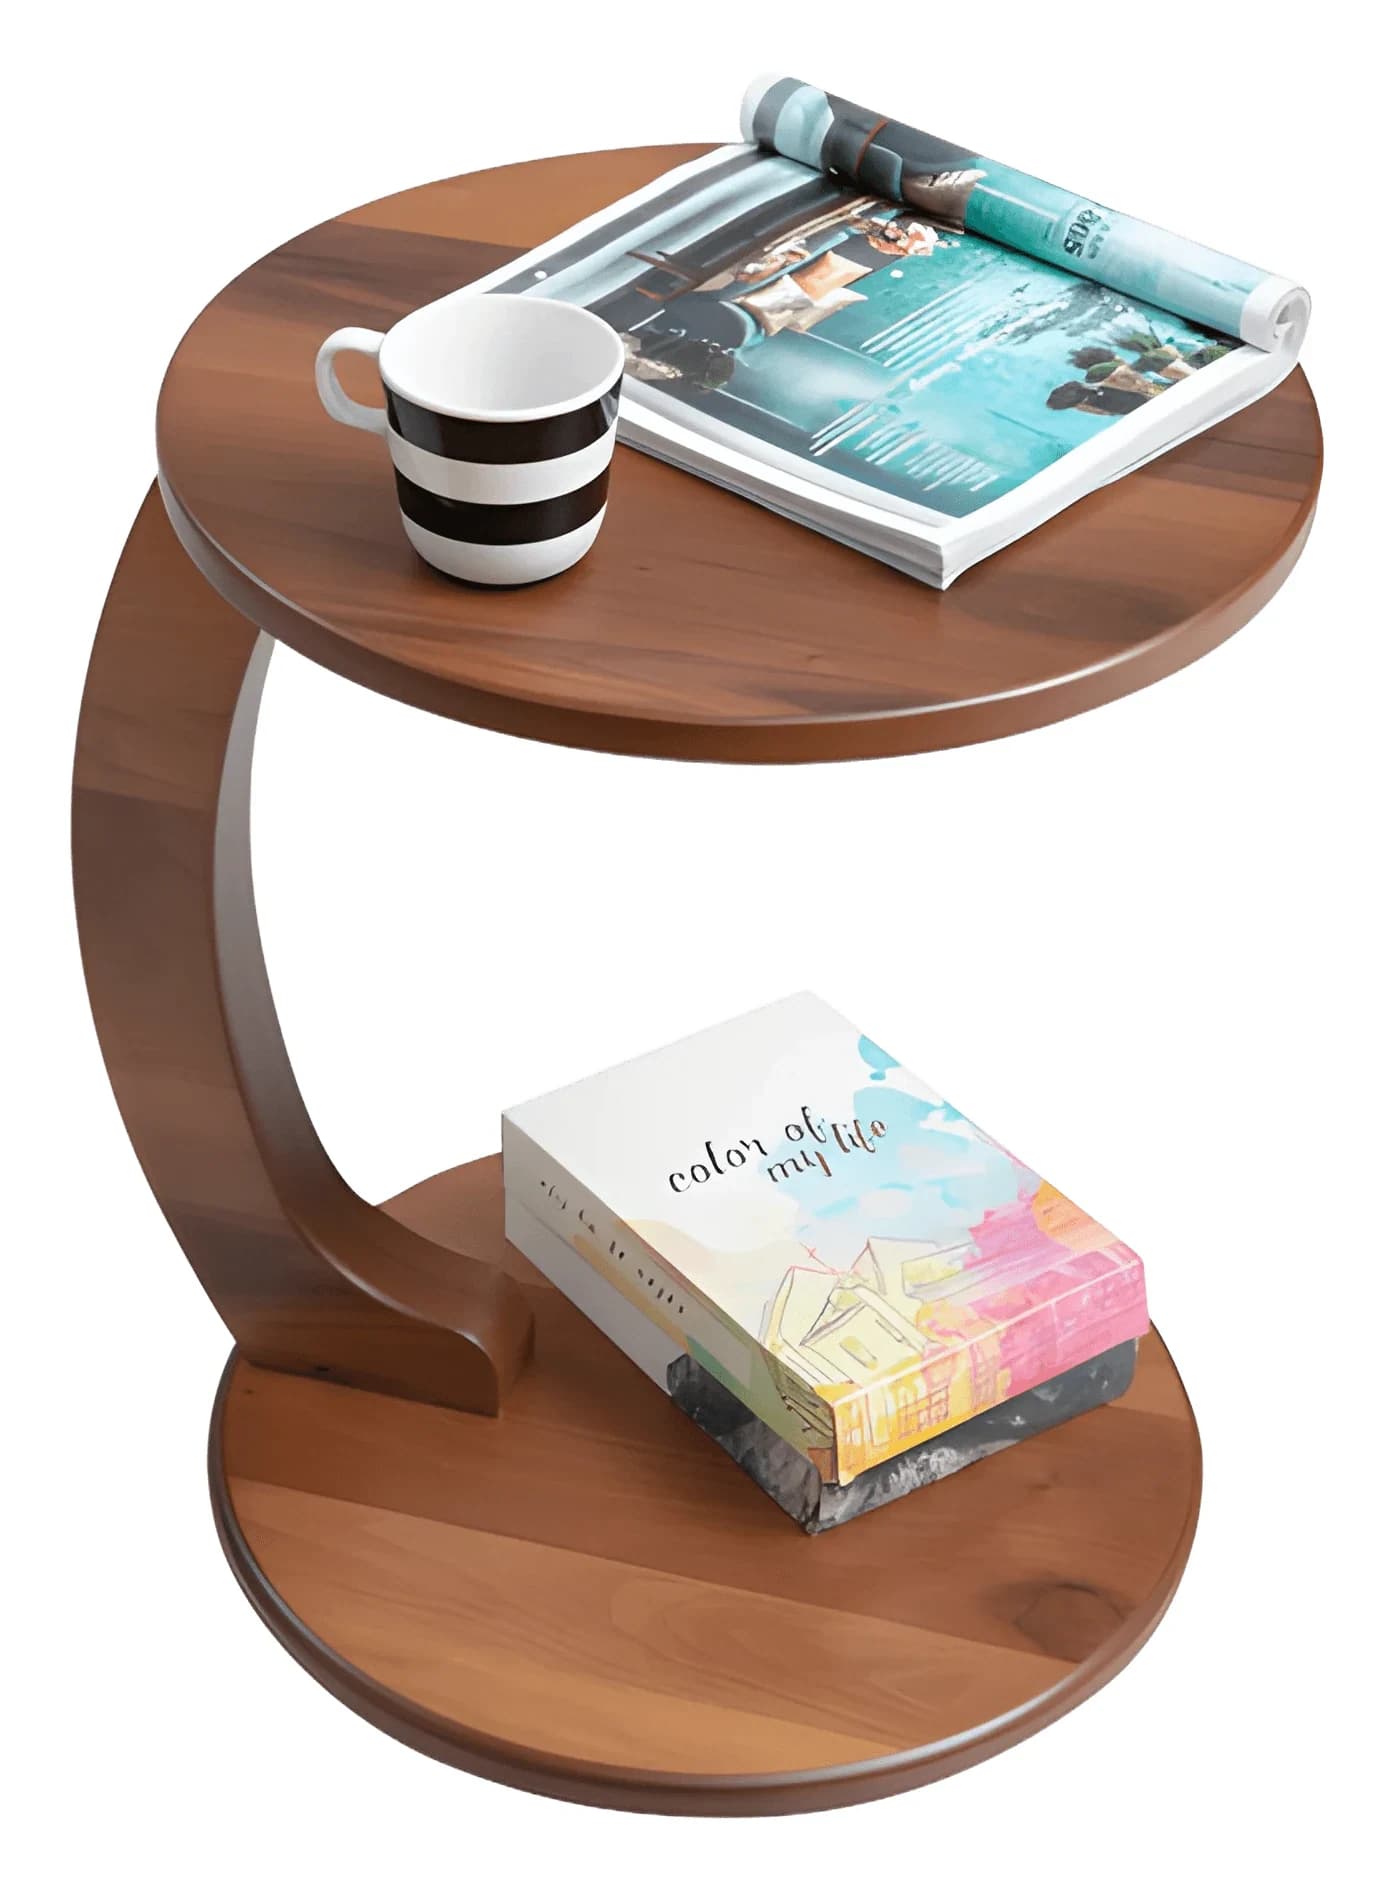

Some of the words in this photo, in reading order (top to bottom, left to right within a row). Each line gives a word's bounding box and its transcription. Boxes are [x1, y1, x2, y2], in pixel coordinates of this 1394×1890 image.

[668, 1140, 768, 1193] color
[784, 1105, 827, 1144] of
[767, 1149, 832, 1182] my
